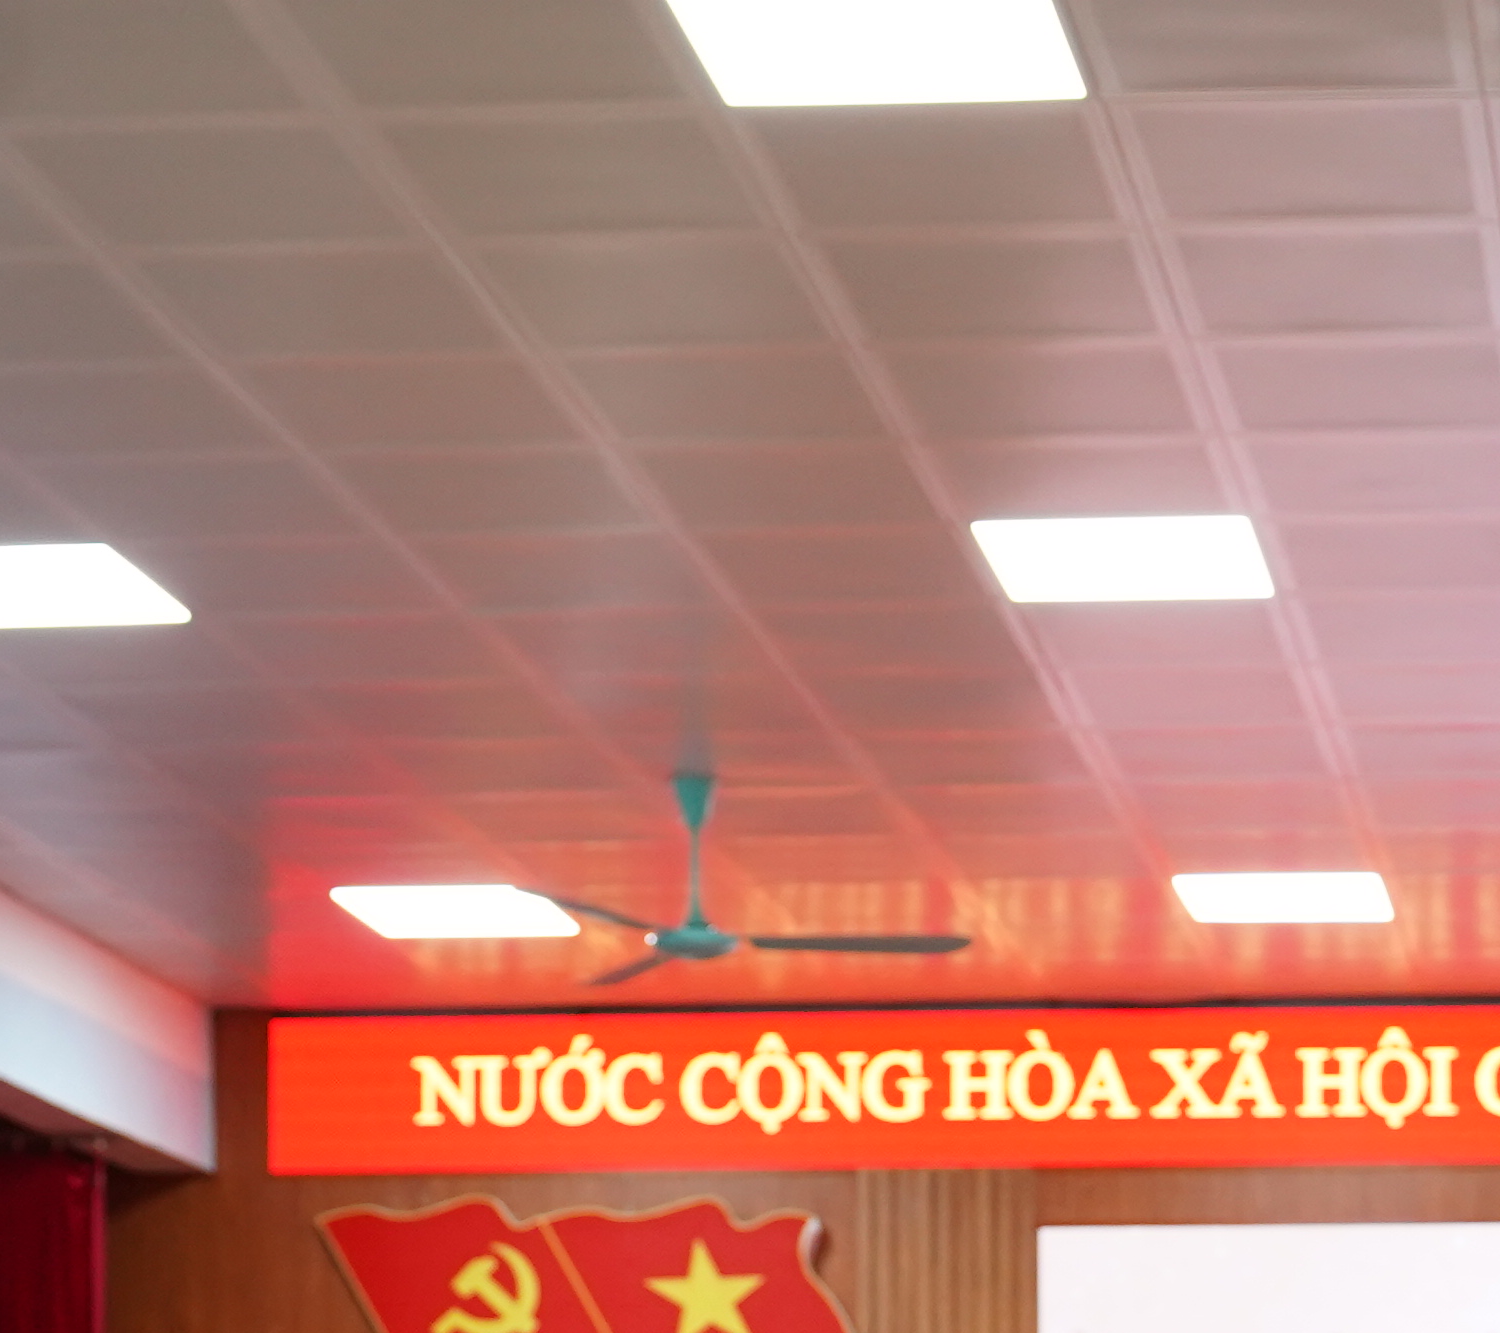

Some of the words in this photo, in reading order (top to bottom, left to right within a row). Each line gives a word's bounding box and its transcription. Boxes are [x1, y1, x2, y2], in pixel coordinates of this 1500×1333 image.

[411, 1034, 664, 1127] NƯỚC
[679, 1032, 932, 1135] CỘNG
[942, 1025, 1140, 1121] HÒA
[1149, 1031, 1286, 1119] XÃ
[1295, 1026, 1459, 1129] HỘI
